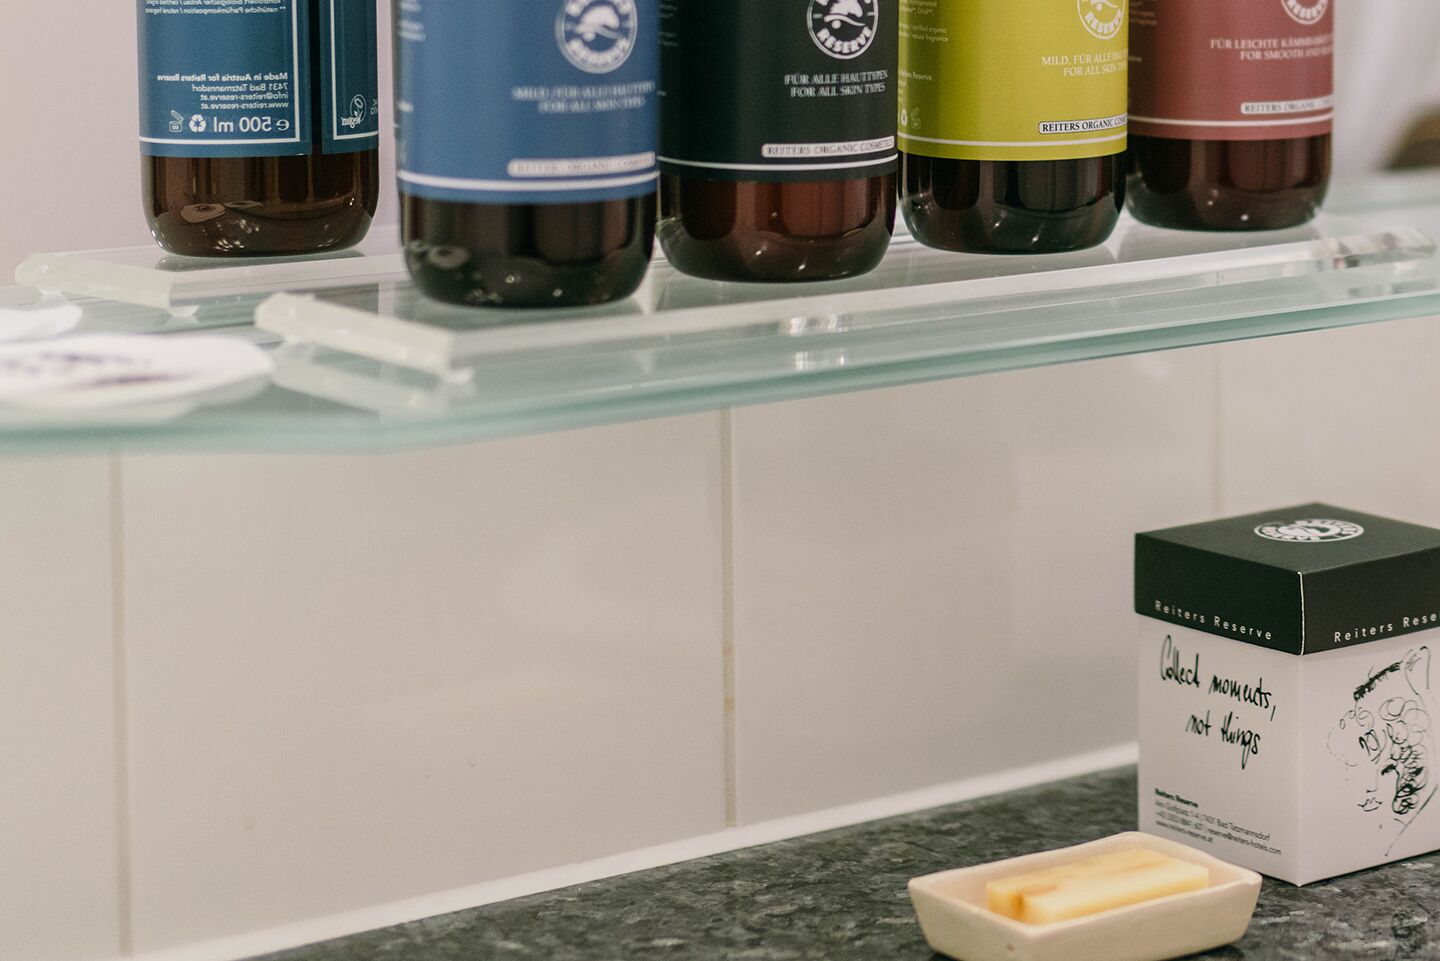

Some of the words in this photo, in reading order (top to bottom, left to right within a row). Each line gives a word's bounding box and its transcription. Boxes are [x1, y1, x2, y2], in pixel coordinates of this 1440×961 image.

[816, 26, 873, 53] RESERVE
[1210, 37, 1232, 49] FÜR
[1235, 38, 1279, 49] LEICHTE
[1073, 53, 1092, 65] FÜR
[1240, 50, 1262, 60] FOR
[1263, 48, 1304, 60] SMOOTH
[1064, 67, 1083, 77] FOR
[1085, 65, 1100, 75] ALL
[784, 72, 810, 85] FÜR
[810, 73, 840, 85] ALLE
[790, 86, 816, 98] FOR
[817, 86, 839, 97] ALL
[840, 84, 864, 96] SKIN
[1245, 103, 1282, 112] REITERS
[1042, 123, 1080, 132] REITERS
[1082, 118, 1113, 130] ORGANIC
[1154, 600, 1205, 624] Reiters
[1213, 615, 1272, 640] Reserve
[1334, 623, 1393, 643] Reiters
[1160, 634, 1200, 688] Collect
[1185, 710, 1212, 737] not
[1221, 711, 1261, 770] things
